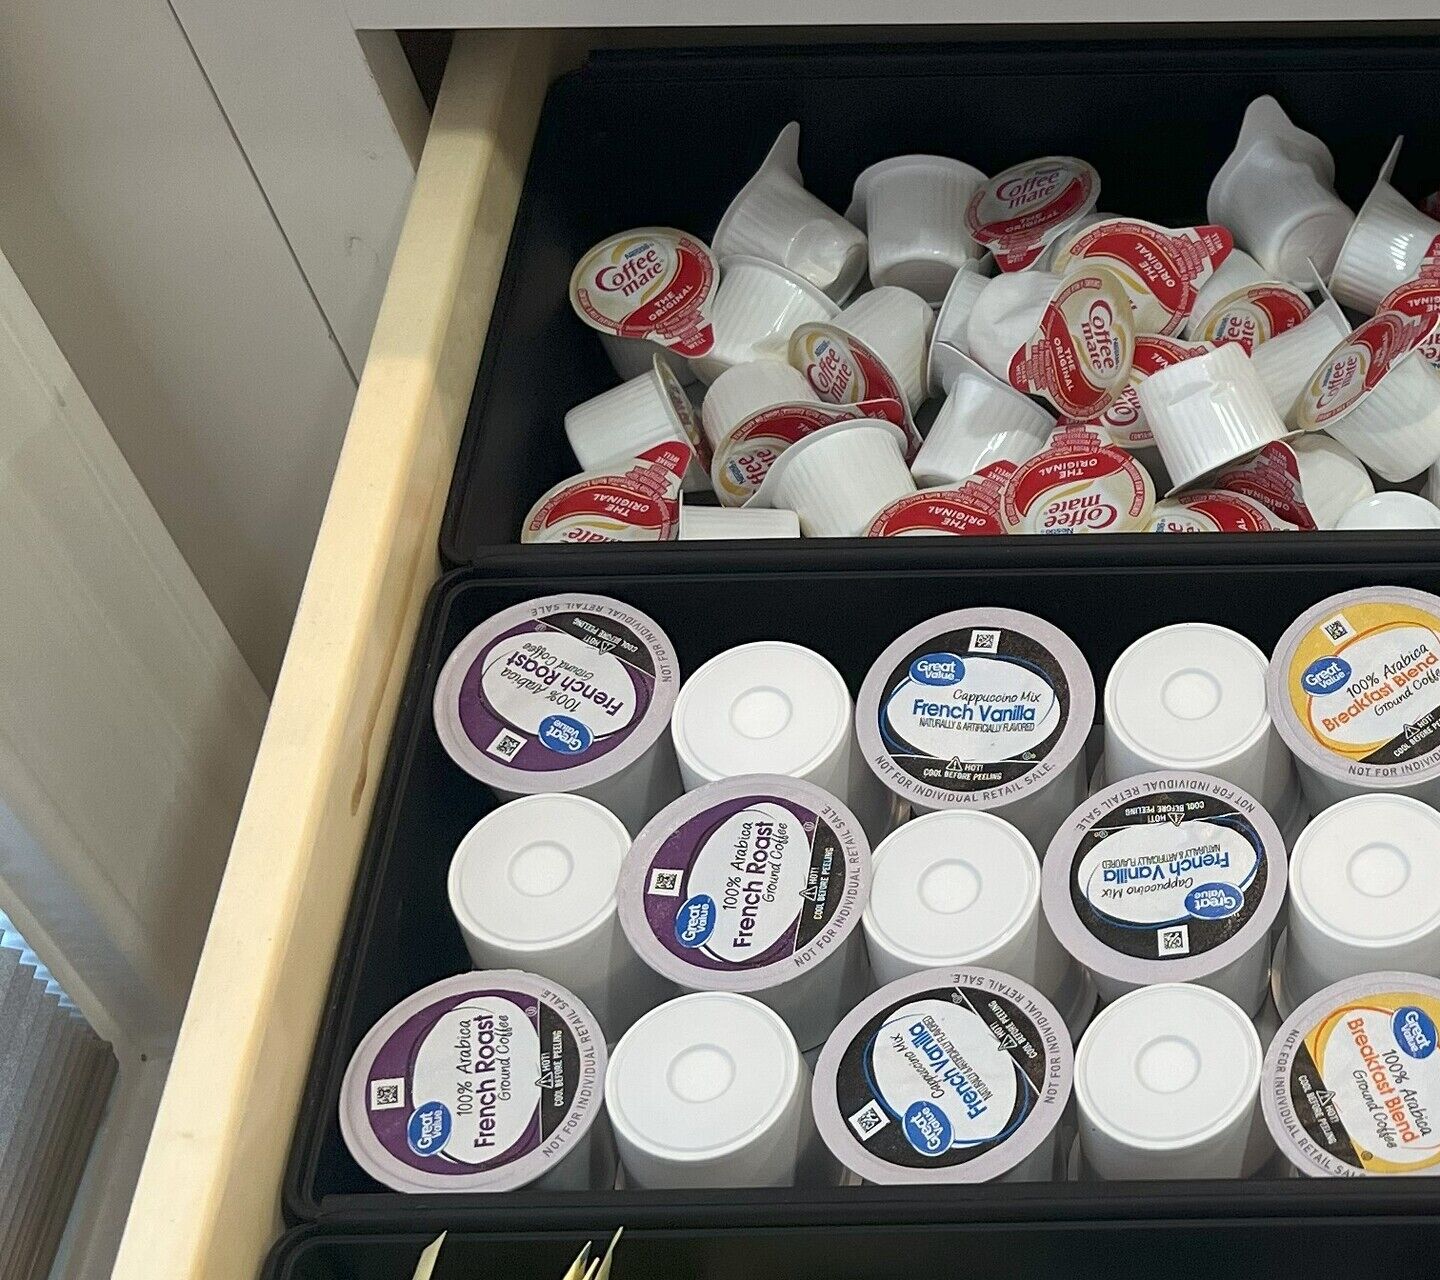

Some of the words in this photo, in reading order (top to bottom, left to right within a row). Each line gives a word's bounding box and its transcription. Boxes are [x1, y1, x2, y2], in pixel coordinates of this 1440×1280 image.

[996, 172, 1060, 201] Coffee
[1008, 184, 1056, 209] mate
[595, 248, 656, 292] Coffee
[621, 262, 662, 297] mate
[1134, 242, 1176, 288] ORIGINAL
[1138, 260, 1160, 282] THE
[648, 284, 693, 321] ORIGINAL
[654, 291, 676, 308] THE
[1081, 321, 1103, 370] mate
[1089, 300, 1116, 370] Coffee
[806, 348, 841, 394] Coffee
[1053, 336, 1075, 392] ORIGINAL
[1063, 348, 1076, 370] THE
[827, 363, 853, 403] mate
[1316, 357, 1346, 409] Coffee
[1038, 458, 1098, 476] ORIGINAL
[1059, 468, 1084, 479] THE
[1043, 503, 1118, 529] Coffee
[1049, 494, 1101, 515] mate
[500, 667, 549, 695] Arabica
[506, 650, 557, 685] Roast
[917, 660, 956, 673] Great
[924, 670, 955, 680] Value
[1305, 661, 1342, 686] Great
[1318, 672, 1346, 689] Value
[1346, 674, 1380, 698] 100%
[1383, 643, 1429, 679] Arabica
[545, 690, 582, 713] 100%
[559, 675, 624, 716] French
[912, 699, 973, 719] French
[979, 704, 1036, 721] Vanilla
[952, 689, 1018, 705] Cappuccino
[1020, 691, 1041, 703] Mix
[1321, 683, 1395, 733] Breakfast
[1397, 653, 1440, 688] Blend
[1373, 687, 1413, 717] Ground
[874, 755, 889, 771] NOT
[891, 771, 911, 789] FOR
[913, 784, 978, 802] INDIVIDUAL
[983, 784, 1022, 801] RETAIL
[731, 821, 754, 871] Arabica
[746, 820, 774, 879] Roast
[771, 822, 789, 860] Coffee
[762, 861, 781, 903] Ground
[1103, 865, 1165, 885] Vanilla
[1175, 852, 1230, 879] French
[723, 876, 742, 911] 100%
[1101, 888, 1123, 899] Mix
[1126, 877, 1194, 894] Cappuccino
[681, 903, 702, 942] Great
[695, 903, 710, 933] Value
[733, 882, 764, 948] French
[455, 1019, 472, 1074] Arabica
[475, 1015, 495, 1074] Roast
[497, 1015, 513, 1054] Coffee
[890, 1032, 908, 1054] Mix
[908, 1021, 951, 1072] Vanilla
[498, 1057, 512, 1101] Ground
[904, 1050, 945, 1099] Cappuccino
[1347, 1018, 1395, 1096] Breakfast
[1385, 1094, 1420, 1144] Blend
[1381, 1049, 1410, 1084] 100%
[1399, 1086, 1433, 1137] Arabica
[456, 1081, 473, 1117] 100%
[949, 1068, 988, 1119] French
[474, 1078, 495, 1148] French
